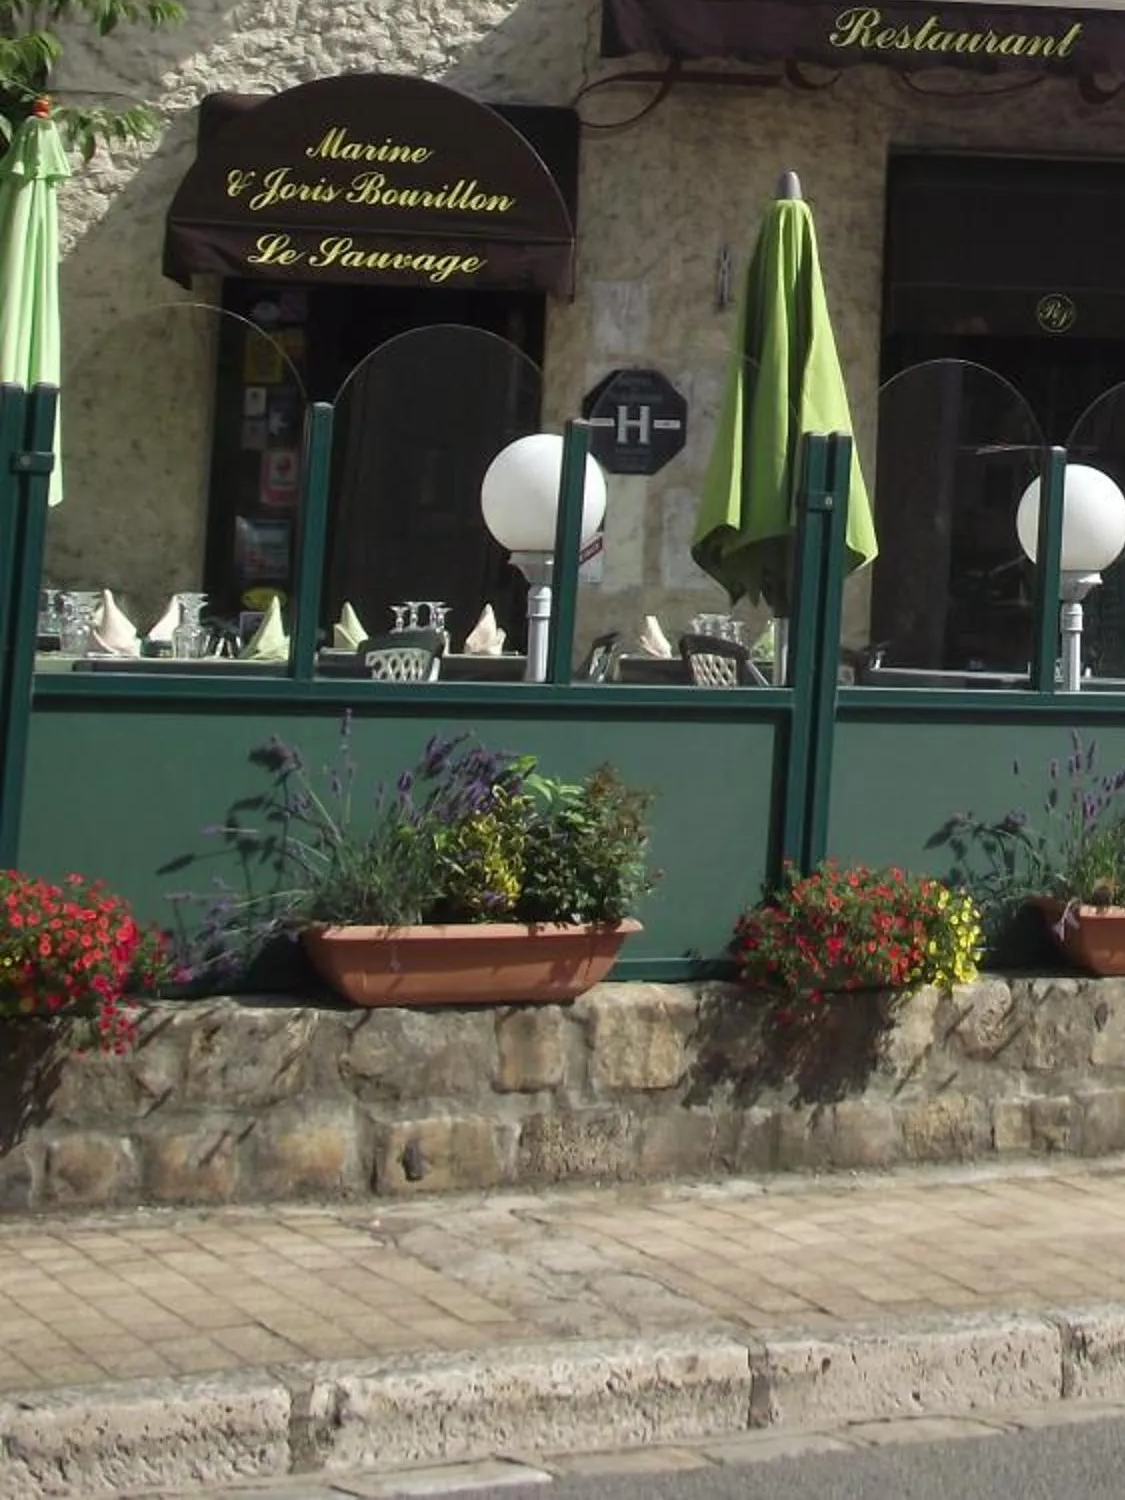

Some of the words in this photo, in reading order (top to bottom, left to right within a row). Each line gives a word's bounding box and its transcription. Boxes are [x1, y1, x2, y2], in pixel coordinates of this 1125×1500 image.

[828, 6, 1084, 58] Restaurant
[305, 126, 434, 164] Marine
[226, 168, 257, 198] &
[249, 166, 343, 212] Joris
[345, 171, 517, 213] Bourillon
[246, 232, 306, 266] Le
[308, 236, 489, 284] Sauvage
[616, 404, 651, 445] H
